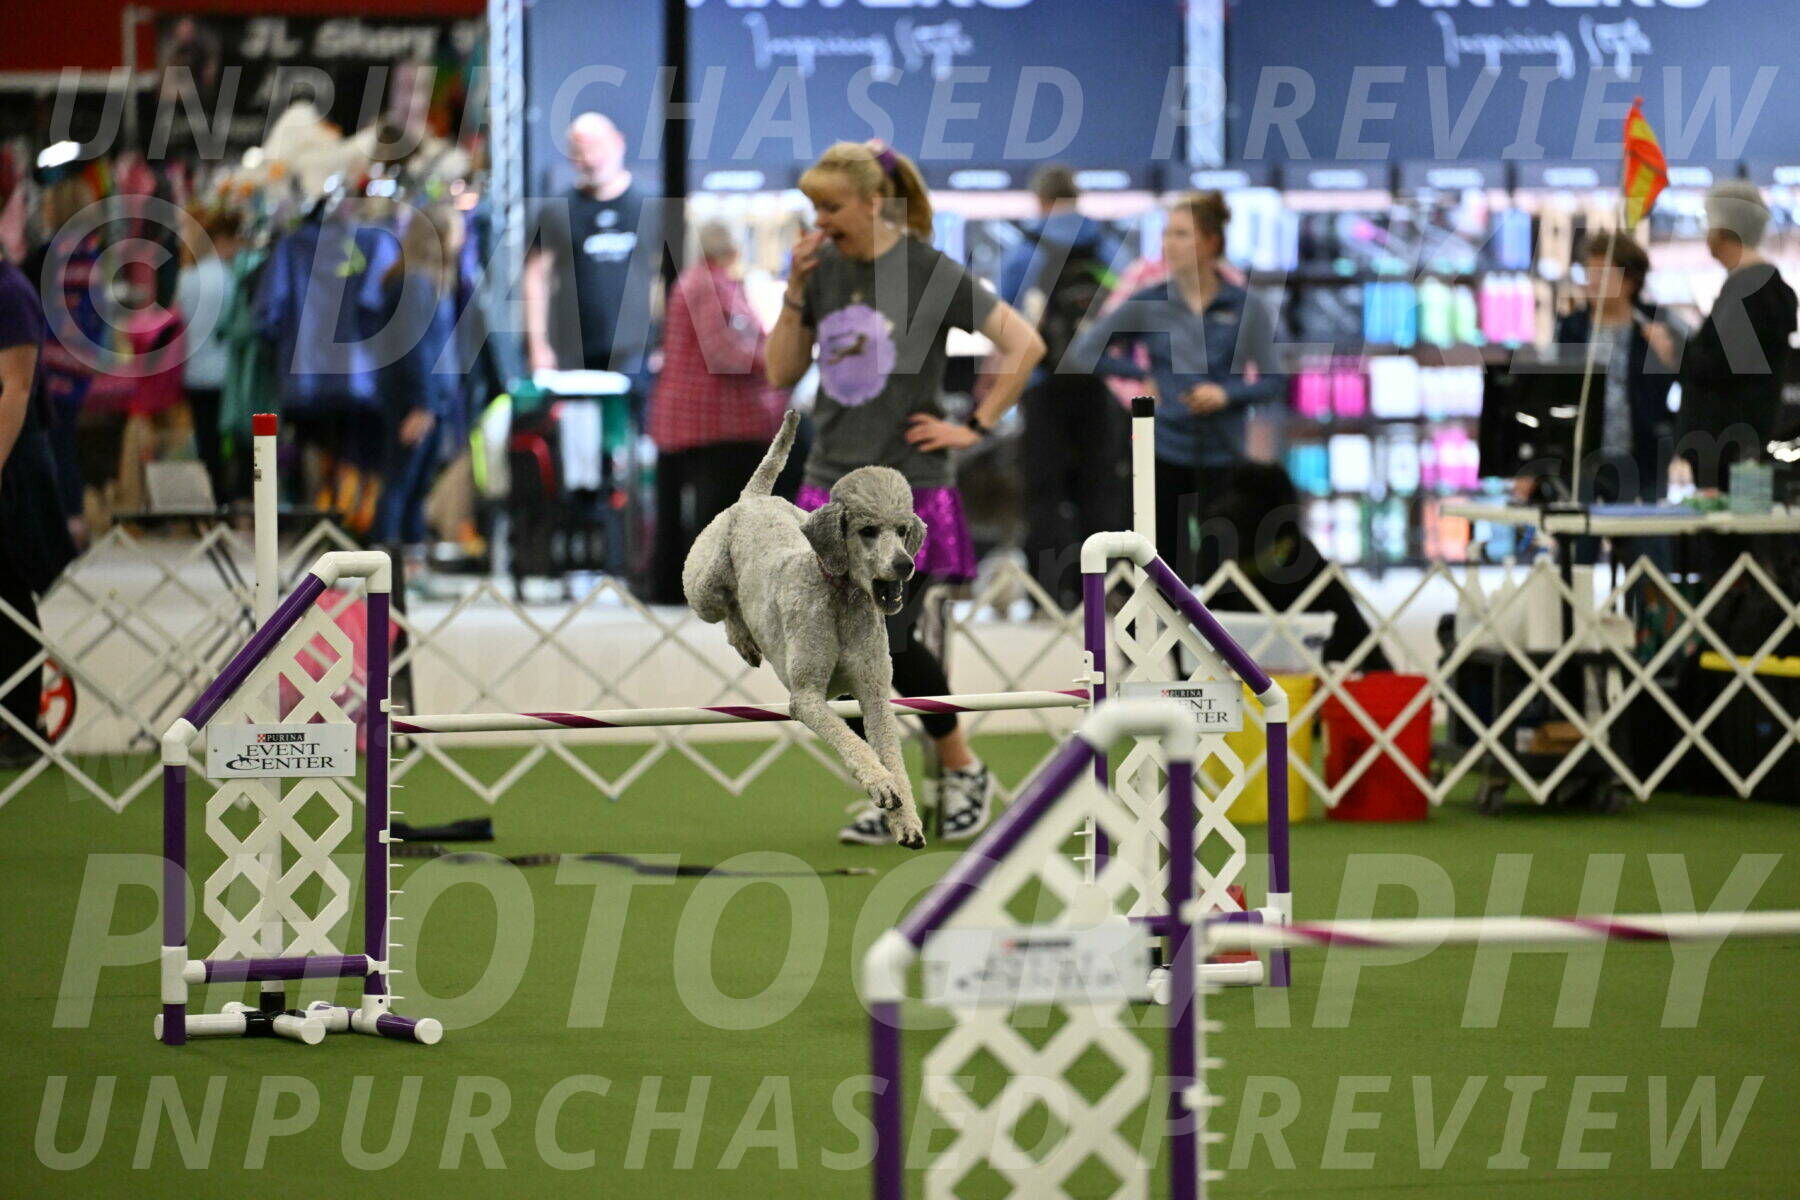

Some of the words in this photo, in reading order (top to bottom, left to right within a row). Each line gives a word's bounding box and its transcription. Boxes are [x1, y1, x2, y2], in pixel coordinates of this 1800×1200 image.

[266, 733, 303, 742] PURINA
[246, 743, 320, 757] EVENT
[226, 755, 335, 770] CENTER
